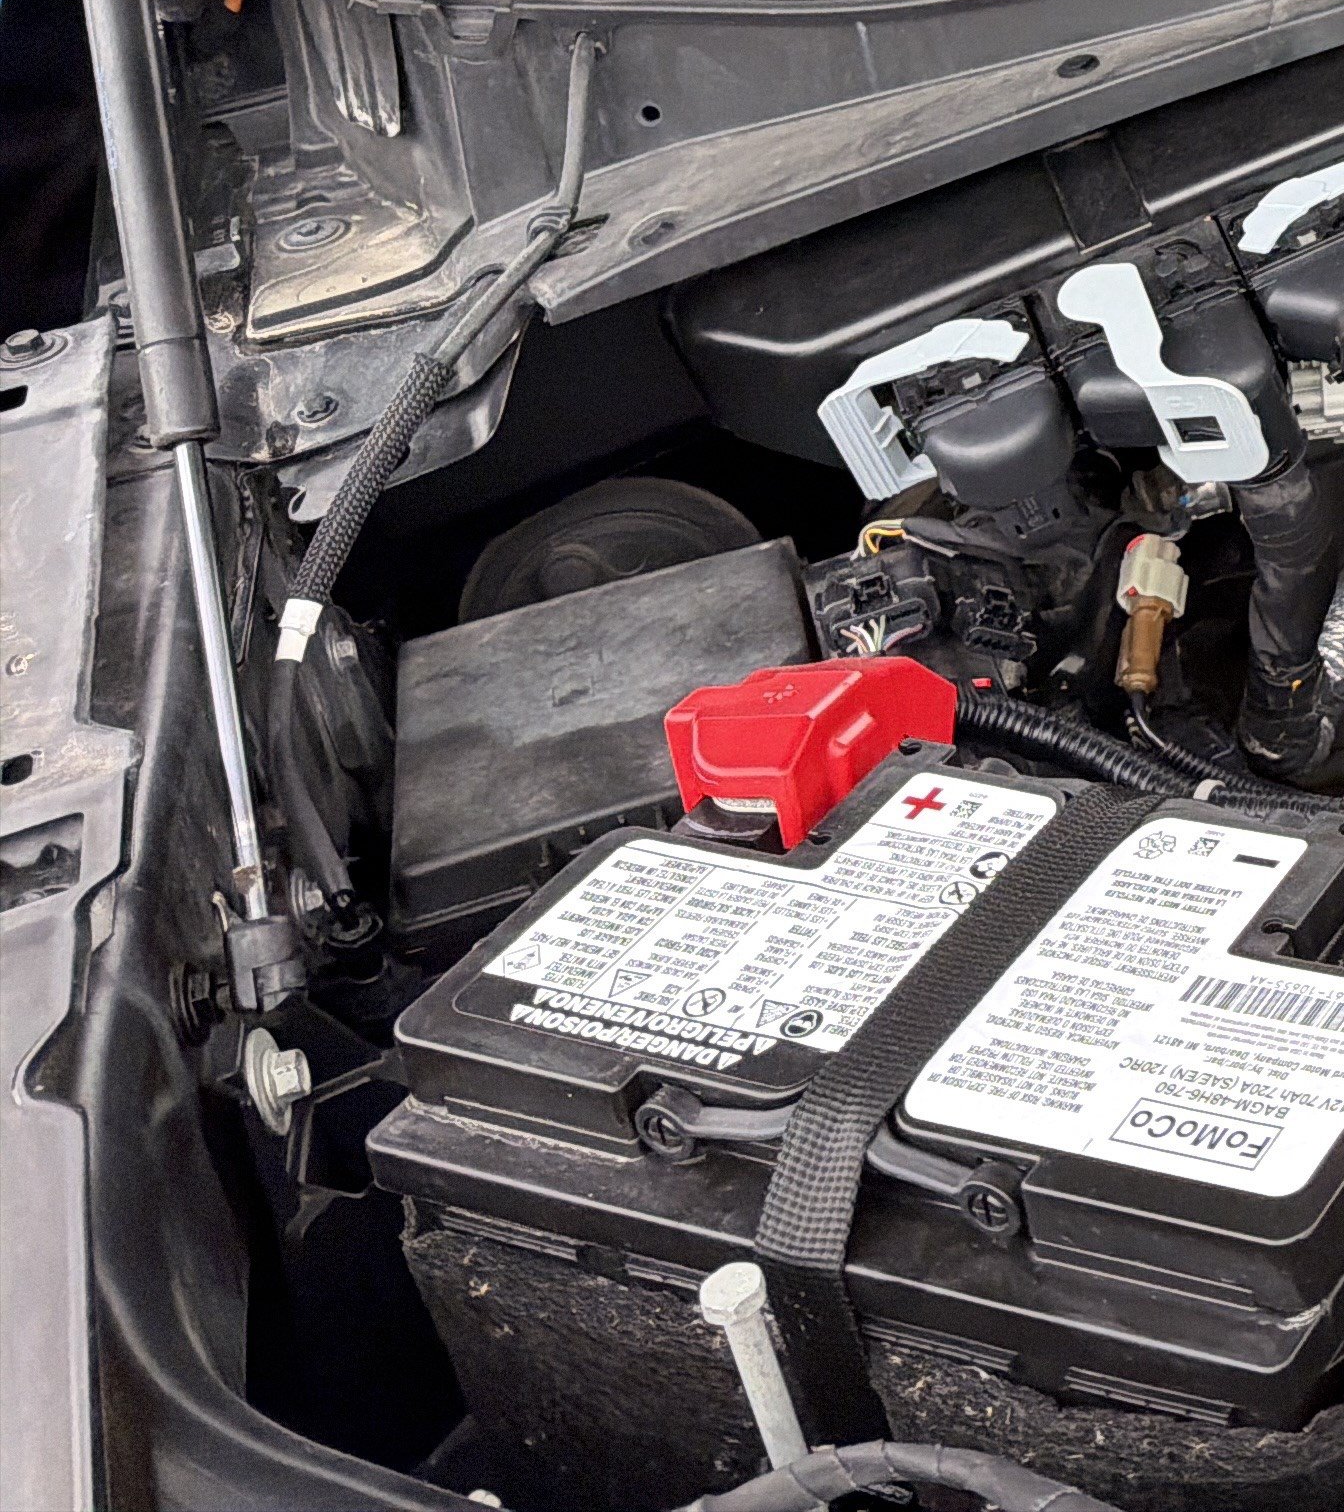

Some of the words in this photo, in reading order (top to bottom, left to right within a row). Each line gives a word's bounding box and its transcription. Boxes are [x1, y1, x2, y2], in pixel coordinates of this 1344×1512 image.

[1112, 880, 1159, 894] RECICLARSE
[1172, 880, 1193, 890] DOIT
[1193, 883, 1231, 896] BATTERIE
[1105, 889, 1145, 903] RECYCLED
[1159, 888, 1181, 898] DEBE
[1230, 890, 1243, 899] LA
[1145, 897, 1158, 906] BE
[1157, 900, 1181, 909] MUST
[1215, 898, 1228, 907] LA
[1181, 904, 1217, 916] BATTERY
[549, 937, 572, 948] HELP
[601, 949, 621, 959] GET
[1077, 976, 1091, 987] DE
[1089, 979, 1135, 996] CORRECTAS
[1020, 988, 1039, 998] USO
[1038, 991, 1061, 1003] PARA
[1073, 987, 1091, 998] LAS
[1090, 991, 1110, 1002] SIGA
[1054, 1006, 1065, 1015] NI
[1059, 996, 1117, 1015] RECOMENDADO
[1065, 1008, 1107, 1025] DESMONTE
[1117, 1008, 1132, 1018] NO
[549, 992, 755, 1051] PELIGRO/VENENO
[1022, 1022, 1037, 1033] DE
[1061, 1019, 1071, 1029] O
[1106, 1018, 1120, 1027] NO
[525, 1008, 713, 1062] DANGER/POISON
[1034, 1025, 1065, 1039] RIESGO
[1153, 1035, 1184, 1047] 48121
[1184, 1041, 1200, 1051] MI
[967, 1045, 1000, 1059] PROPER
[1204, 1043, 1250, 1060] Dearborn,
[948, 1053, 967, 1064] FOR
[1000, 1052, 1034, 1067] FOLLOW
[1047, 1051, 1091, 1067] CHARGING
[1254, 1053, 1300, 1071] Company,
[947, 1065, 963, 1075] OR
[966, 1057, 1028, 1077] RECOMMENDED
[1054, 1064, 1095, 1079] INVERTED
[1118, 1056, 1168, 1076] 120RC
[1300, 1064, 1331, 1077] Motor
[927, 1072, 942, 1083] OR
[961, 1068, 1017, 1087] DISASSEMBLE
[1026, 1070, 1047, 1081] NOT
[1169, 1065, 1240, 1090] (SAE/EN)
[941, 1076, 987, 1093] EXPLOSION
[1015, 1080, 1035, 1091] NOT
[1033, 1083, 1049, 1094] DO
[1240, 1080, 1278, 1099] 720A
[1006, 1090, 1021, 1101] OF
[1019, 1093, 1041, 1105] RISK
[1155, 1081, 1290, 1119] BAGM-48H6-760
[1279, 1089, 1319, 1108] 70Ah
[1130, 1110, 1270, 1159] FoMoCo
